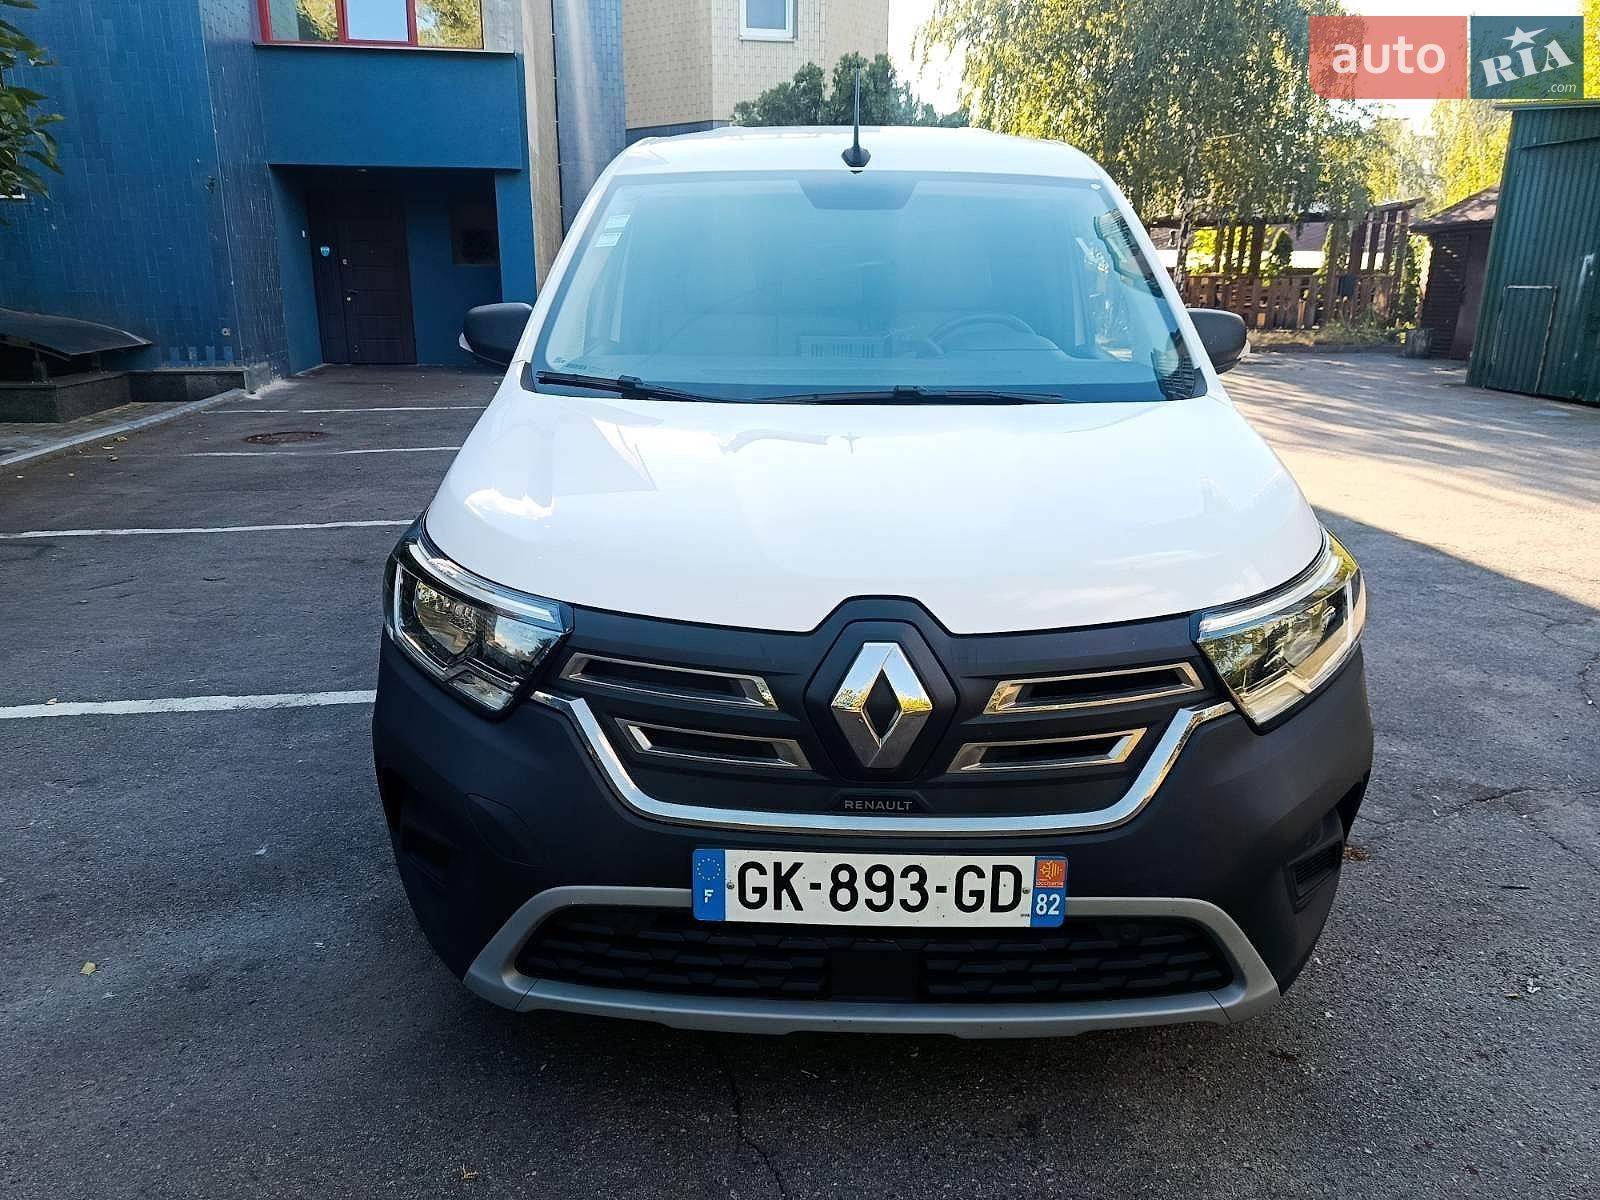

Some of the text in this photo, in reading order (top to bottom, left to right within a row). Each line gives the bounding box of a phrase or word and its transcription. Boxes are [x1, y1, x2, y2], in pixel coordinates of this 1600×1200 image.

[844, 800, 913, 810] RENAULT
[704, 889, 714, 903] F
[737, 861, 1022, 913] GK-893-GD
[1036, 893, 1060, 915] 82
